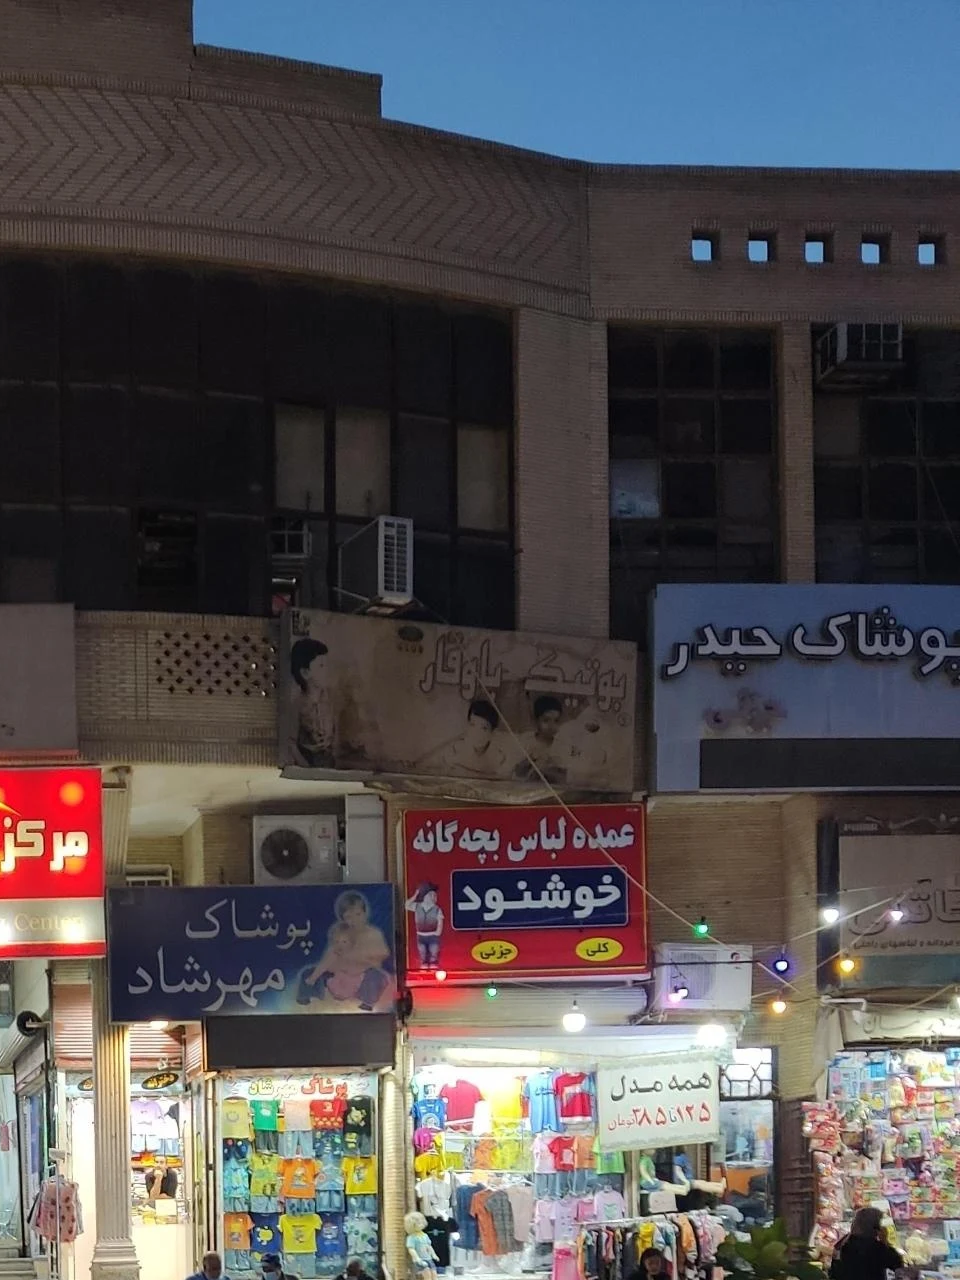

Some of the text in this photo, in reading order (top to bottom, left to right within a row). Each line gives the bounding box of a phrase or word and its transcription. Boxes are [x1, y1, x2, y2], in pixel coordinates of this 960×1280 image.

[419, 630, 627, 713] بوتیک باوقار
[661, 624, 782, 680] حیدر
[0, 816, 89, 873] مرکز
[507, 815, 568, 862] لباس
[573, 821, 635, 849] عمده
[457, 873, 622, 922] خوشنود
[184, 898, 315, 956] پوشاک
[585, 942, 609, 957] کلی
[127, 945, 286, 1013] مهرشاد
[610, 1071, 713, 1102] همه مدل
[675, 1102, 712, 1124] ۱۲۵
